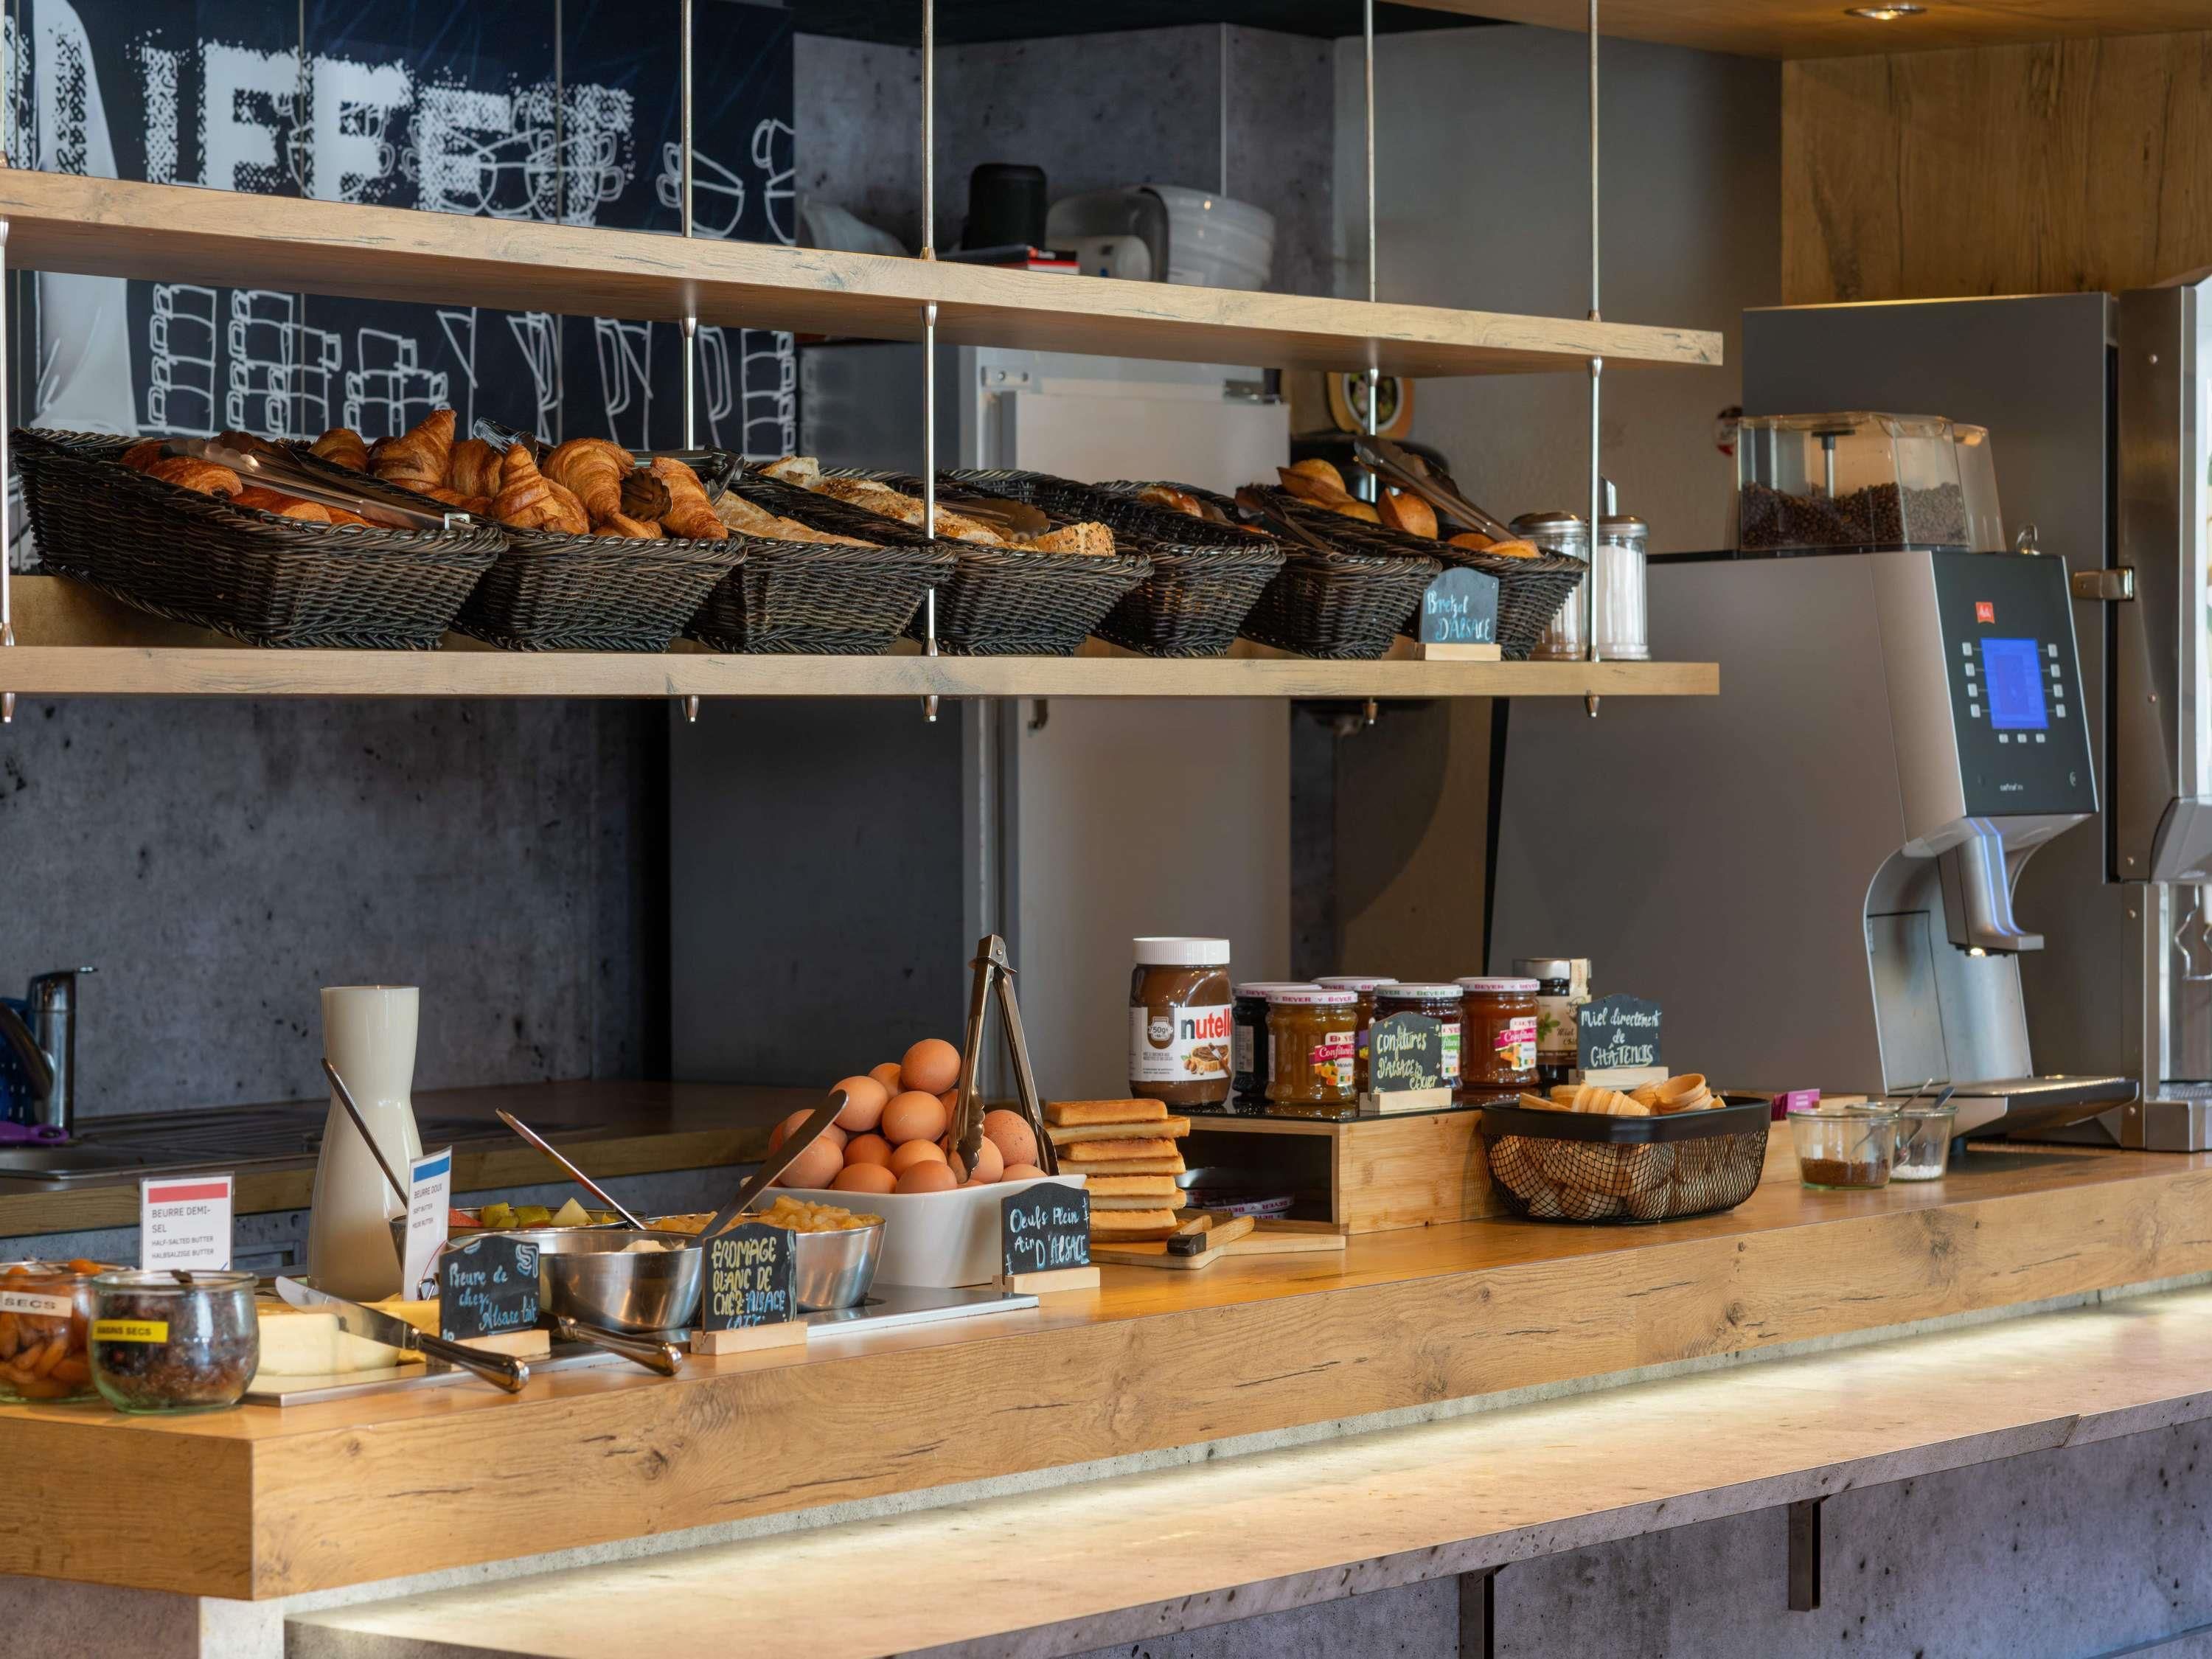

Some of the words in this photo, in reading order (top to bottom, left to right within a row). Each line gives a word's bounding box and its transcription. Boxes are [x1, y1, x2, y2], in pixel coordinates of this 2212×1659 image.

[1427, 590, 1469, 618] Bretzel
[1180, 1008, 1232, 1040] nutell
[1581, 1007, 1608, 1027] Miel
[1610, 1007, 1662, 1027] directement
[1613, 1029, 1626, 1044] de
[152, 1206, 184, 1218] BEURRE
[187, 1206, 211, 1216] DEMI-
[1009, 1205, 1048, 1233] Oeufs
[1053, 1206, 1080, 1225] Plein
[152, 1224, 167, 1234] SEL
[152, 1238, 190, 1246] HALF-SALTED
[1015, 1236, 1035, 1253] Air
[192, 1248, 214, 1256] BUTTER
[711, 1237, 776, 1269] FROMAGE
[493, 1265, 508, 1283] de
[712, 1267, 751, 1293] BLANC
[757, 1266, 773, 1292] DE
[4, 1298, 56, 1310] SECS
[459, 1287, 490, 1315] chez
[714, 1290, 745, 1316] CHEZ
[726, 1314, 762, 1330] LAIT
[126, 1327, 152, 1336] SECS
